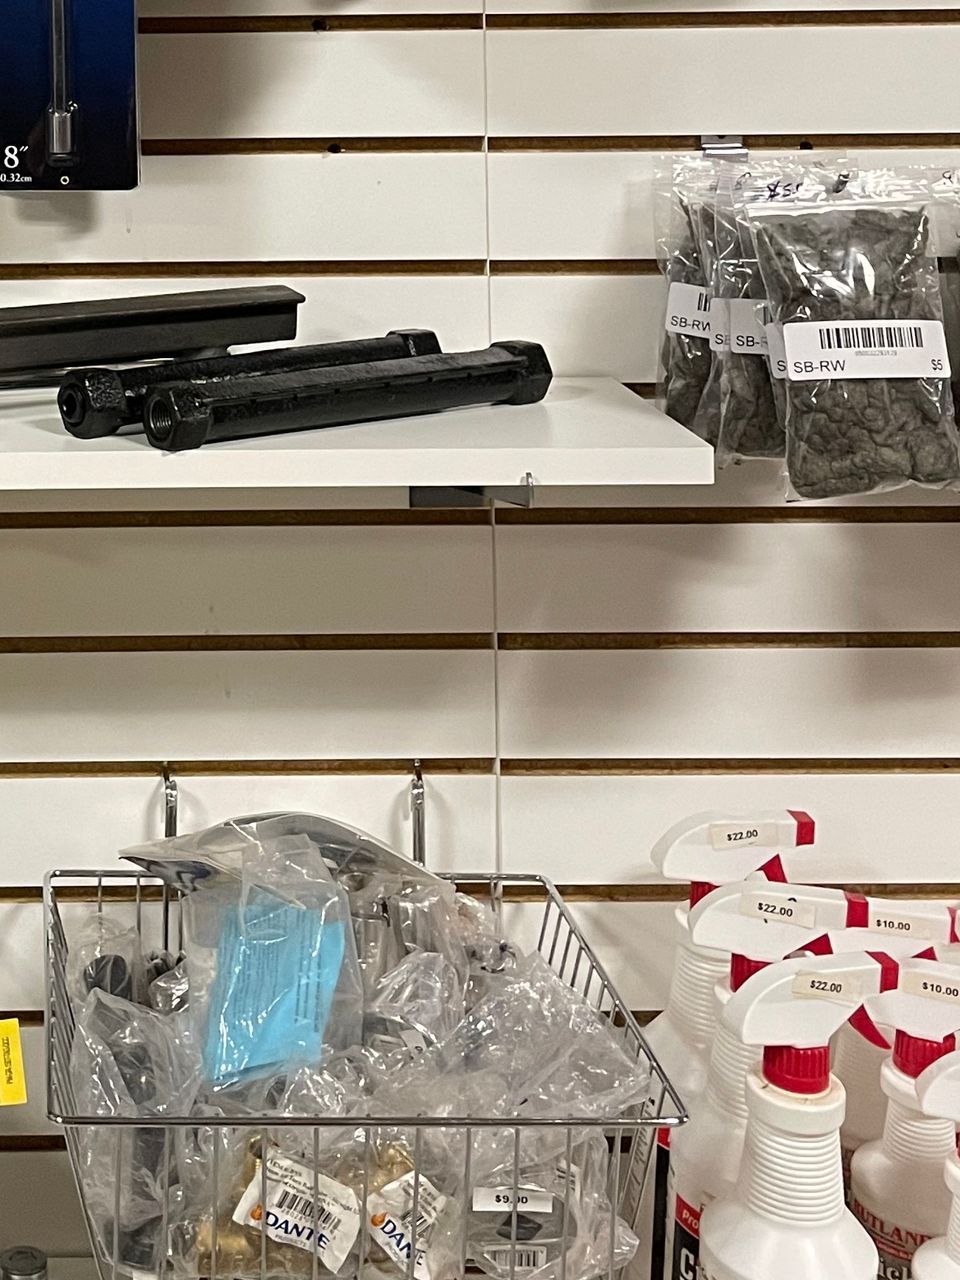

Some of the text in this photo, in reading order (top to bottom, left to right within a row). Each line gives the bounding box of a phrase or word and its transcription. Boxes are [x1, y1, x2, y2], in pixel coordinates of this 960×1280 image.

[793, 358, 944, 374] SB-RW $5
[727, 829, 758, 842] $22.00
[757, 902, 793, 917] $22.00
[876, 919, 911, 931] $10.00
[809, 979, 842, 993] $22.00
[922, 982, 960, 997] $10.00
[265, 1210, 330, 1251] DANTE
